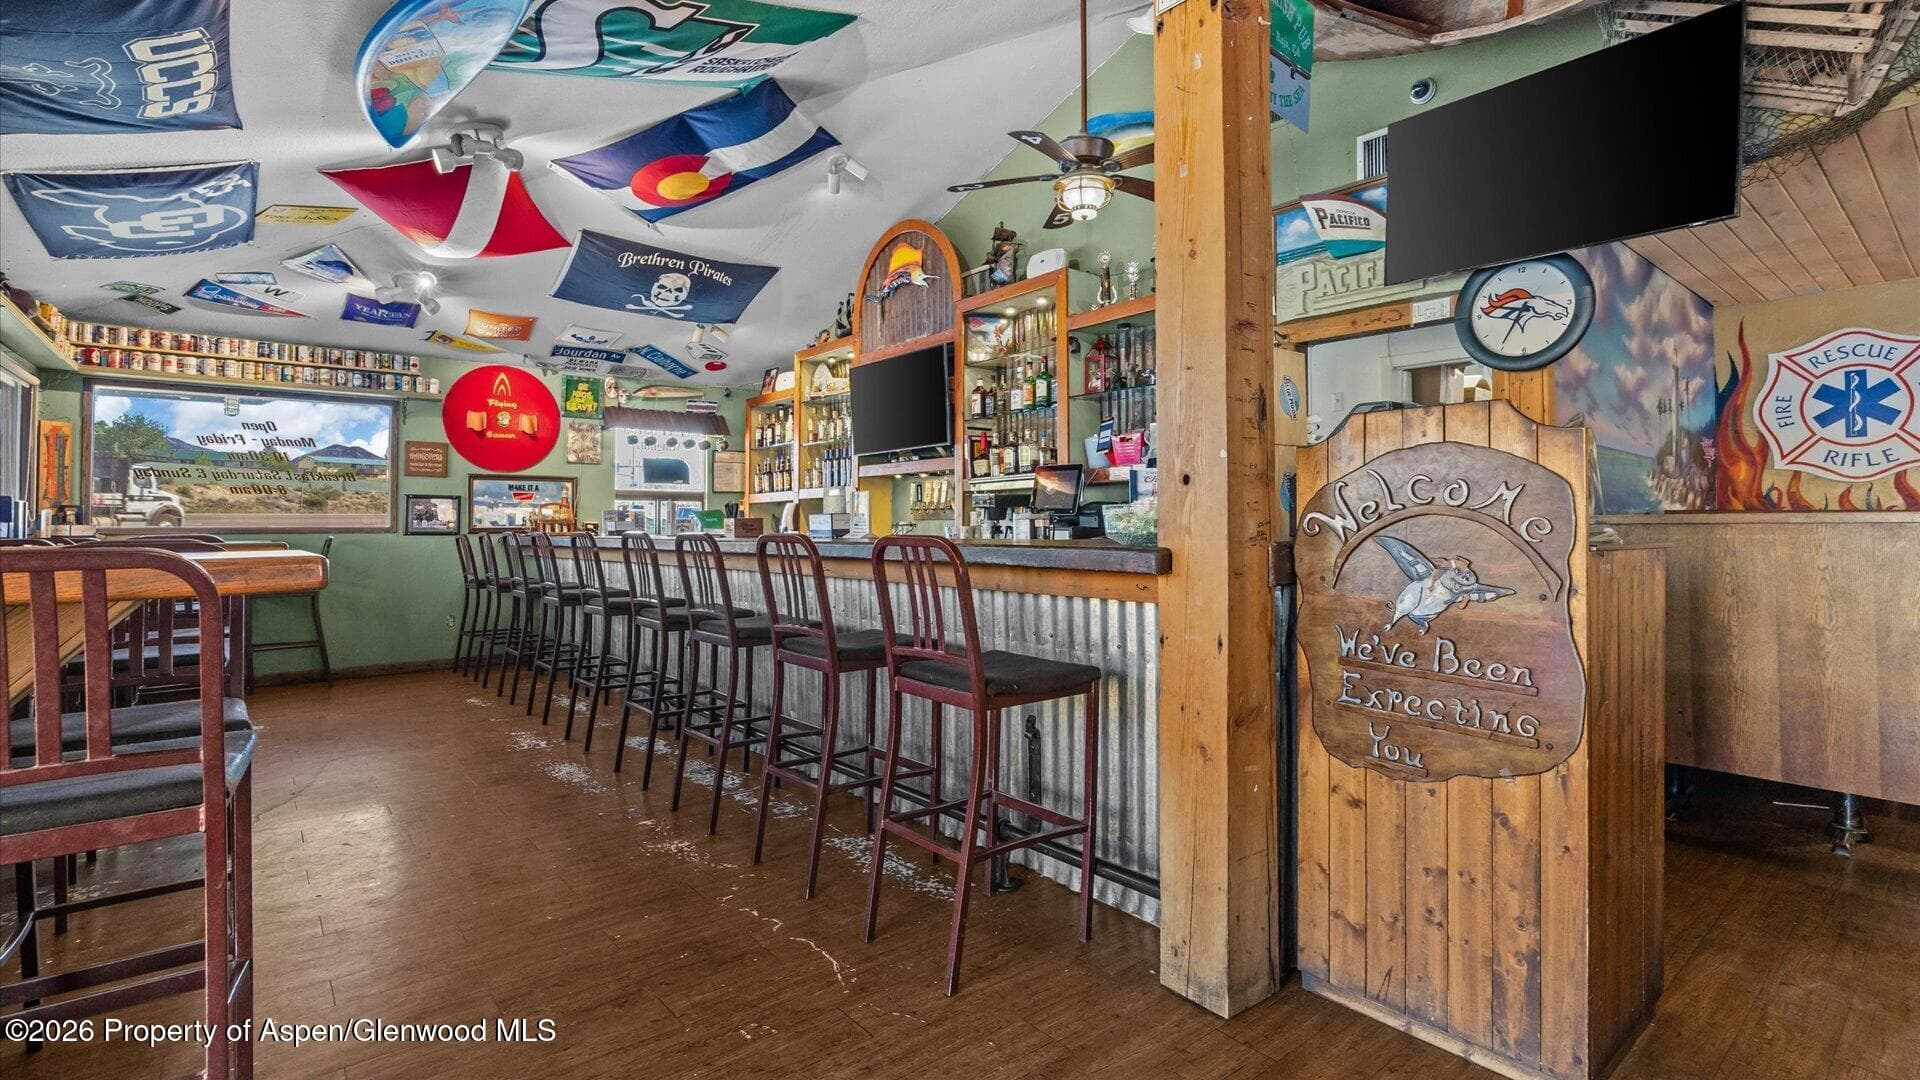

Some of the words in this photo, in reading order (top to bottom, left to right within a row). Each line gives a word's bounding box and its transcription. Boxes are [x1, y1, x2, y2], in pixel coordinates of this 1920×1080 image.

[1293, 16, 1311, 49] PUB
[122, 27, 218, 119] UCCS
[1279, 95, 1293, 107] THE
[1293, 85, 1305, 105] SEA
[1052, 213, 1070, 225] 5
[1312, 207, 1370, 230] PACIFICO
[618, 251, 684, 270] Brethren
[688, 260, 733, 287] Pirates
[1296, 258, 1380, 315] PACIF
[555, 347, 607, 360] Jourdan
[1808, 343, 1898, 369] RESCUE
[487, 399, 517, 409] Flying
[1775, 395, 1795, 428] FIRE
[1823, 448, 1900, 468] RIFLE
[1335, 624, 1416, 669] We've
[1433, 636, 1532, 687] Been
[1368, 722, 1424, 768] You
